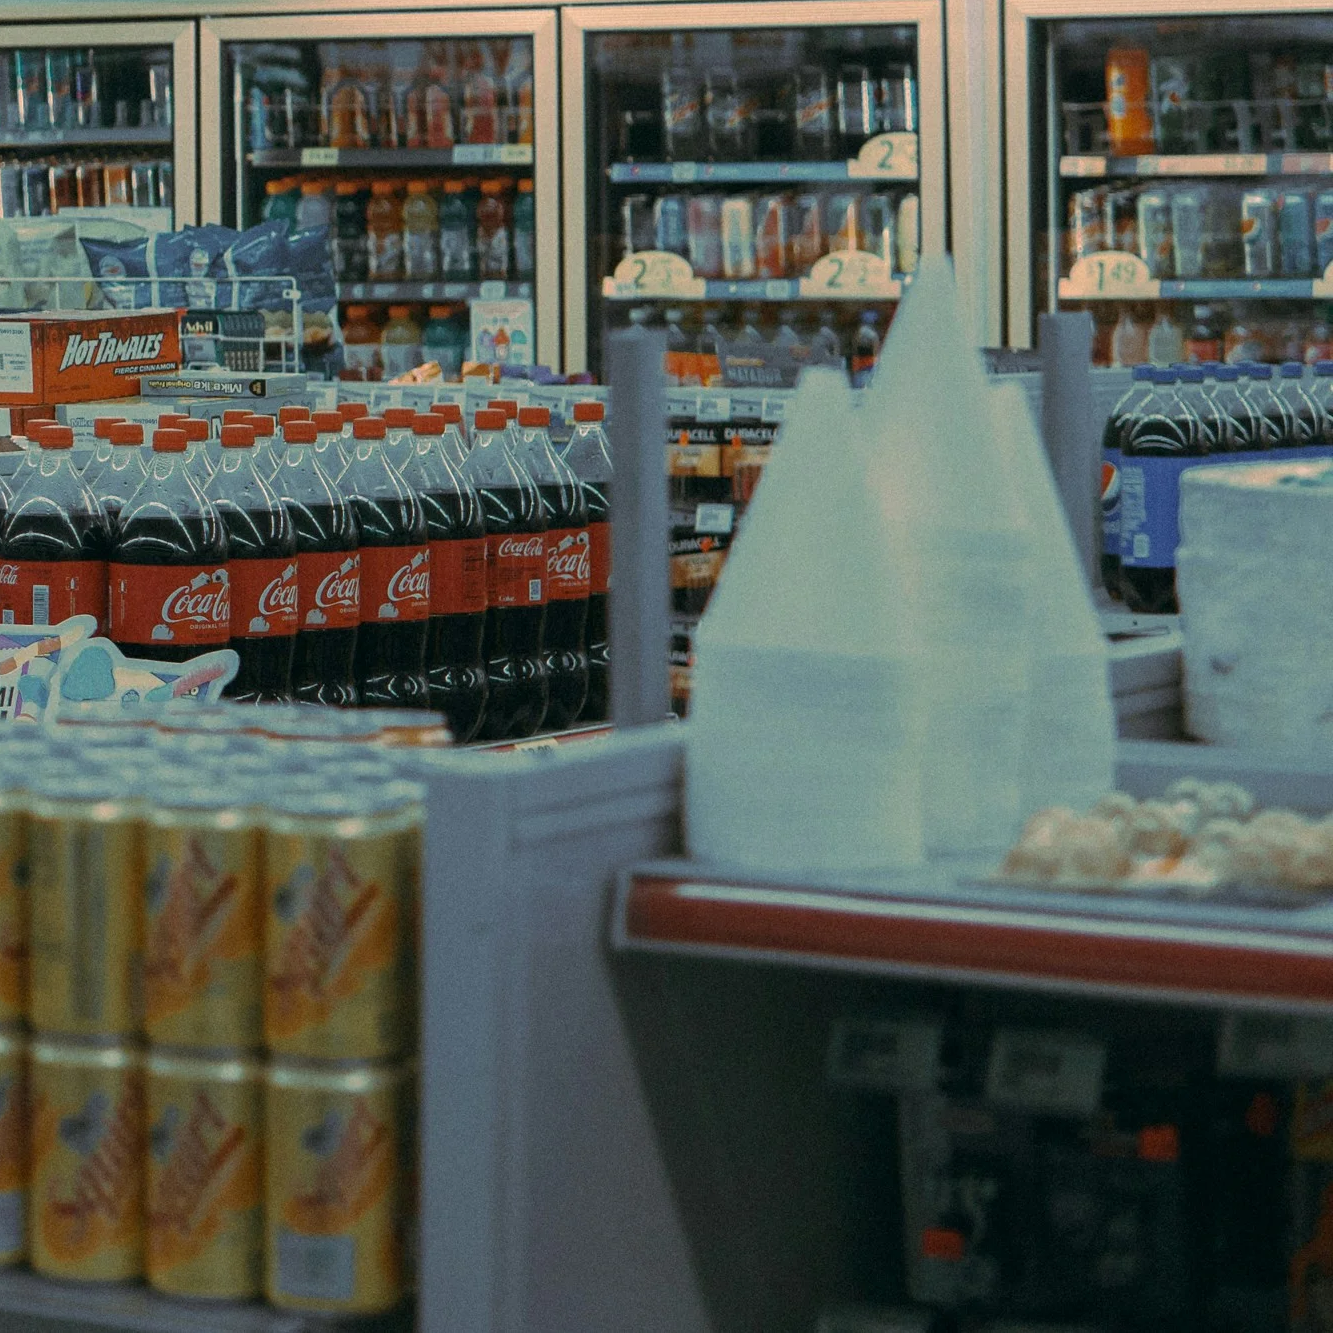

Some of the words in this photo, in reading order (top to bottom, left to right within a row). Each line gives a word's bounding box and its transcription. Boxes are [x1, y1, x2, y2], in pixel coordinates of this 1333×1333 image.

[185, 319, 213, 334] Advil
[114, 366, 139, 376] FIERCE
[139, 362, 176, 374] CINNAMON
